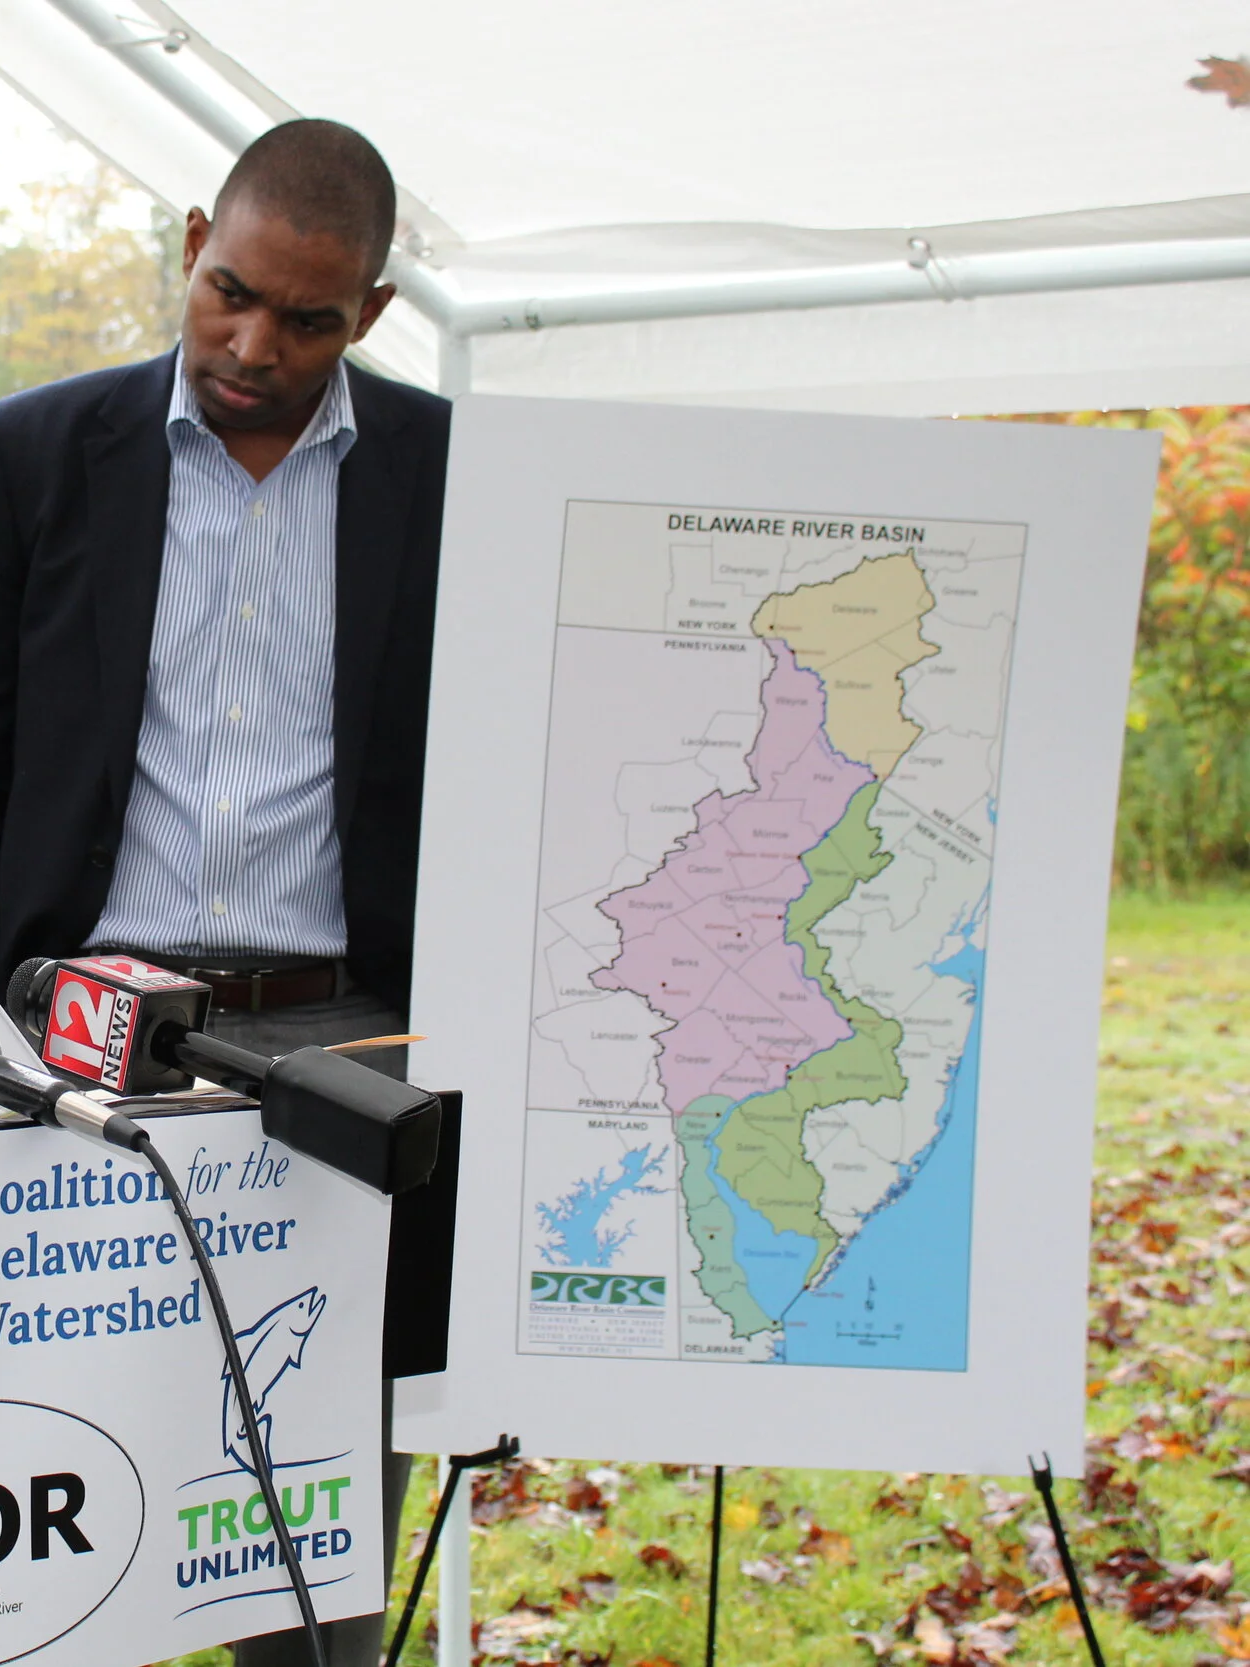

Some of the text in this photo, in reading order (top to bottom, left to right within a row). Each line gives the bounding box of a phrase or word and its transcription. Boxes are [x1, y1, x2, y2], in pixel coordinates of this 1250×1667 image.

[668, 513, 926, 543] DELAWARE RIVER BASIN
[678, 619, 737, 631] NEW YORK
[664, 639, 747, 653] PENNSYLVANIA
[76, 957, 177, 982] 12
[130, 976, 193, 988] NEWS
[48, 980, 115, 1070] 12
[103, 997, 132, 1082] NEWS
[577, 1098, 659, 1111] PENNSYLVANIA
[587, 1119, 649, 1132] MARYLAND
[180, 1147, 232, 1206] for
[238, 1140, 290, 1191] the
[191, 1211, 296, 1261] River
[684, 1343, 746, 1356] DELAWARE
[178, 1476, 351, 1551] TROUT
[177, 1528, 352, 1589] UNLIMITED
